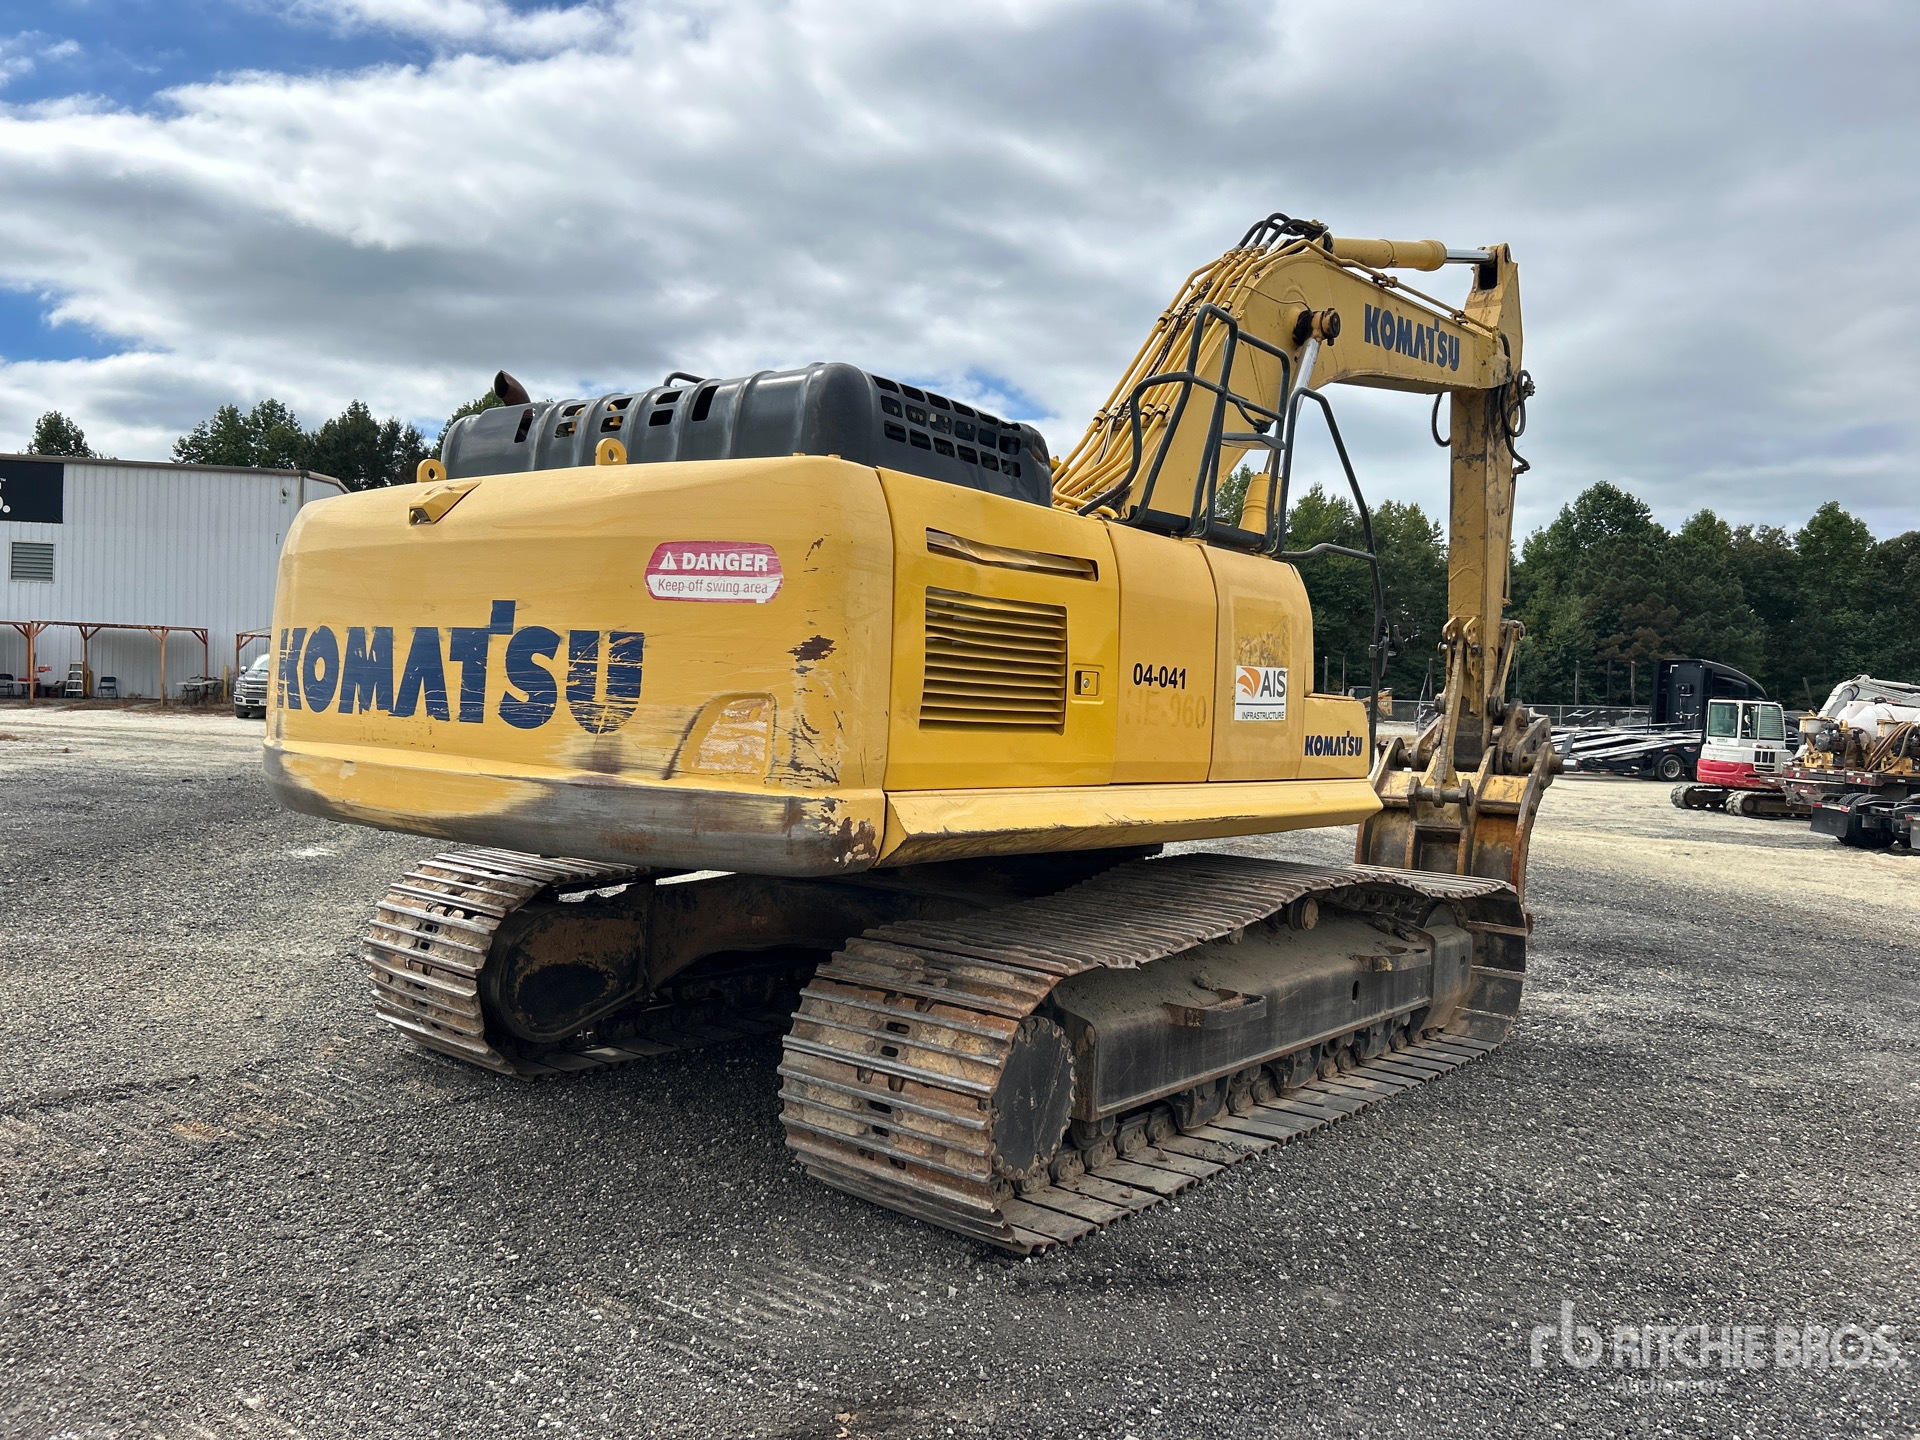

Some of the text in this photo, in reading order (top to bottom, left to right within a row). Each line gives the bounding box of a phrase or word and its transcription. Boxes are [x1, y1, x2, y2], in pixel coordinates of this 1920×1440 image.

[1364, 303, 1460, 372] KOMATSU
[682, 552, 768, 572] DANGER
[658, 578, 768, 595] Keep off swing area
[276, 599, 646, 735] KOMATSU
[1133, 662, 1187, 690] 04-041
[1260, 670, 1286, 698] AIS
[1241, 711, 1285, 720] INFRASTRUCTURE
[1304, 730, 1363, 757] KOMATSU
